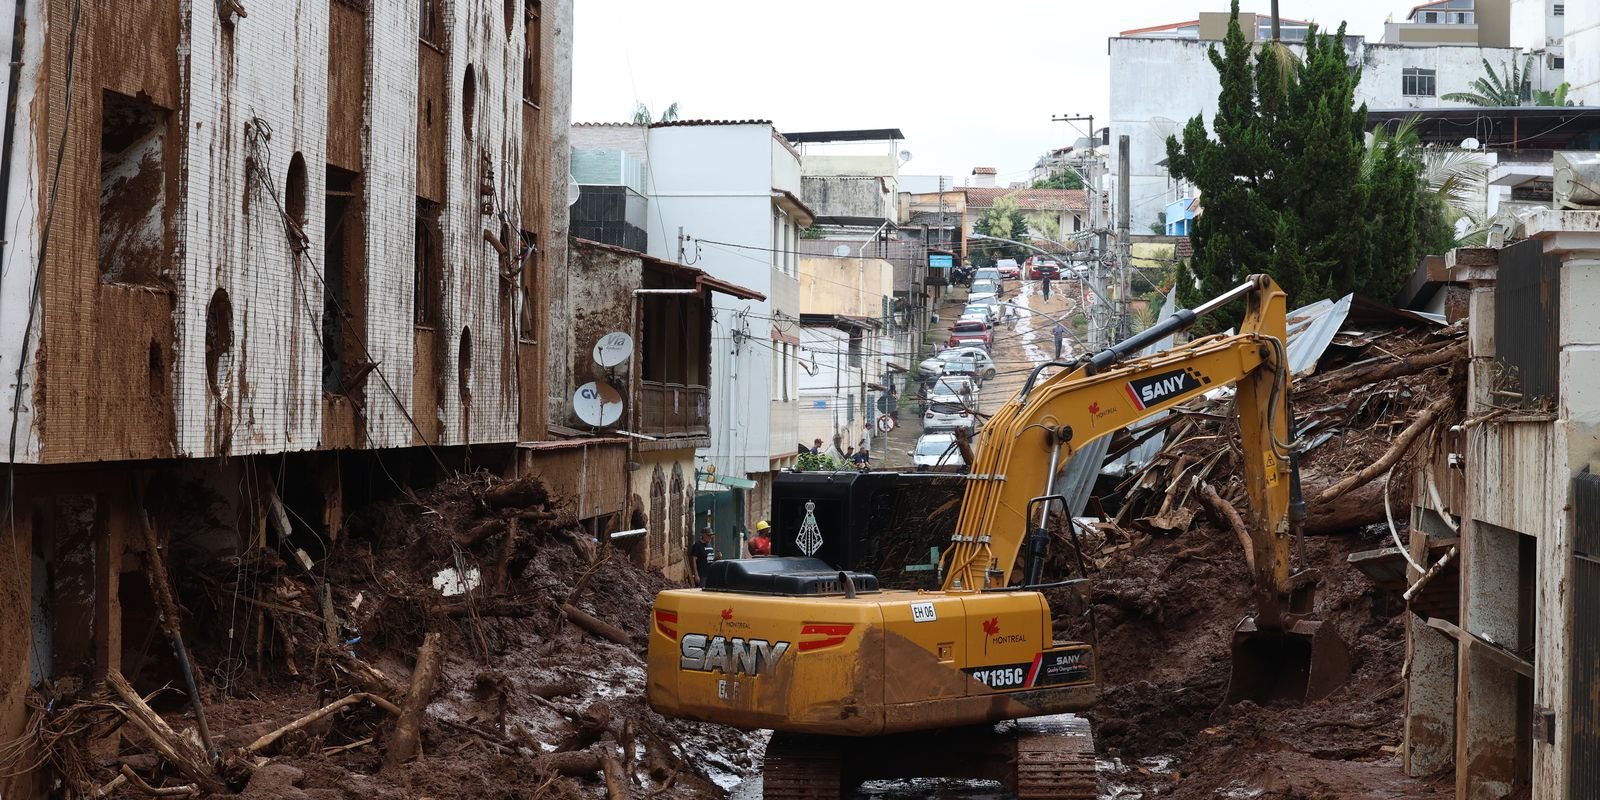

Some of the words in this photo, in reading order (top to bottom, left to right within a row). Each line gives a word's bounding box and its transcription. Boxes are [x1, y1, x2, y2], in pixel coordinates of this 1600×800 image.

[608, 334, 625, 346] Via
[1142, 373, 1185, 402] SANY
[914, 607, 923, 618] EH
[924, 606, 934, 618] 06
[992, 634, 1027, 645] MONTREAL
[681, 633, 790, 676] SANY
[1056, 655, 1080, 666] SANY
[973, 668, 1023, 687] SY135C
